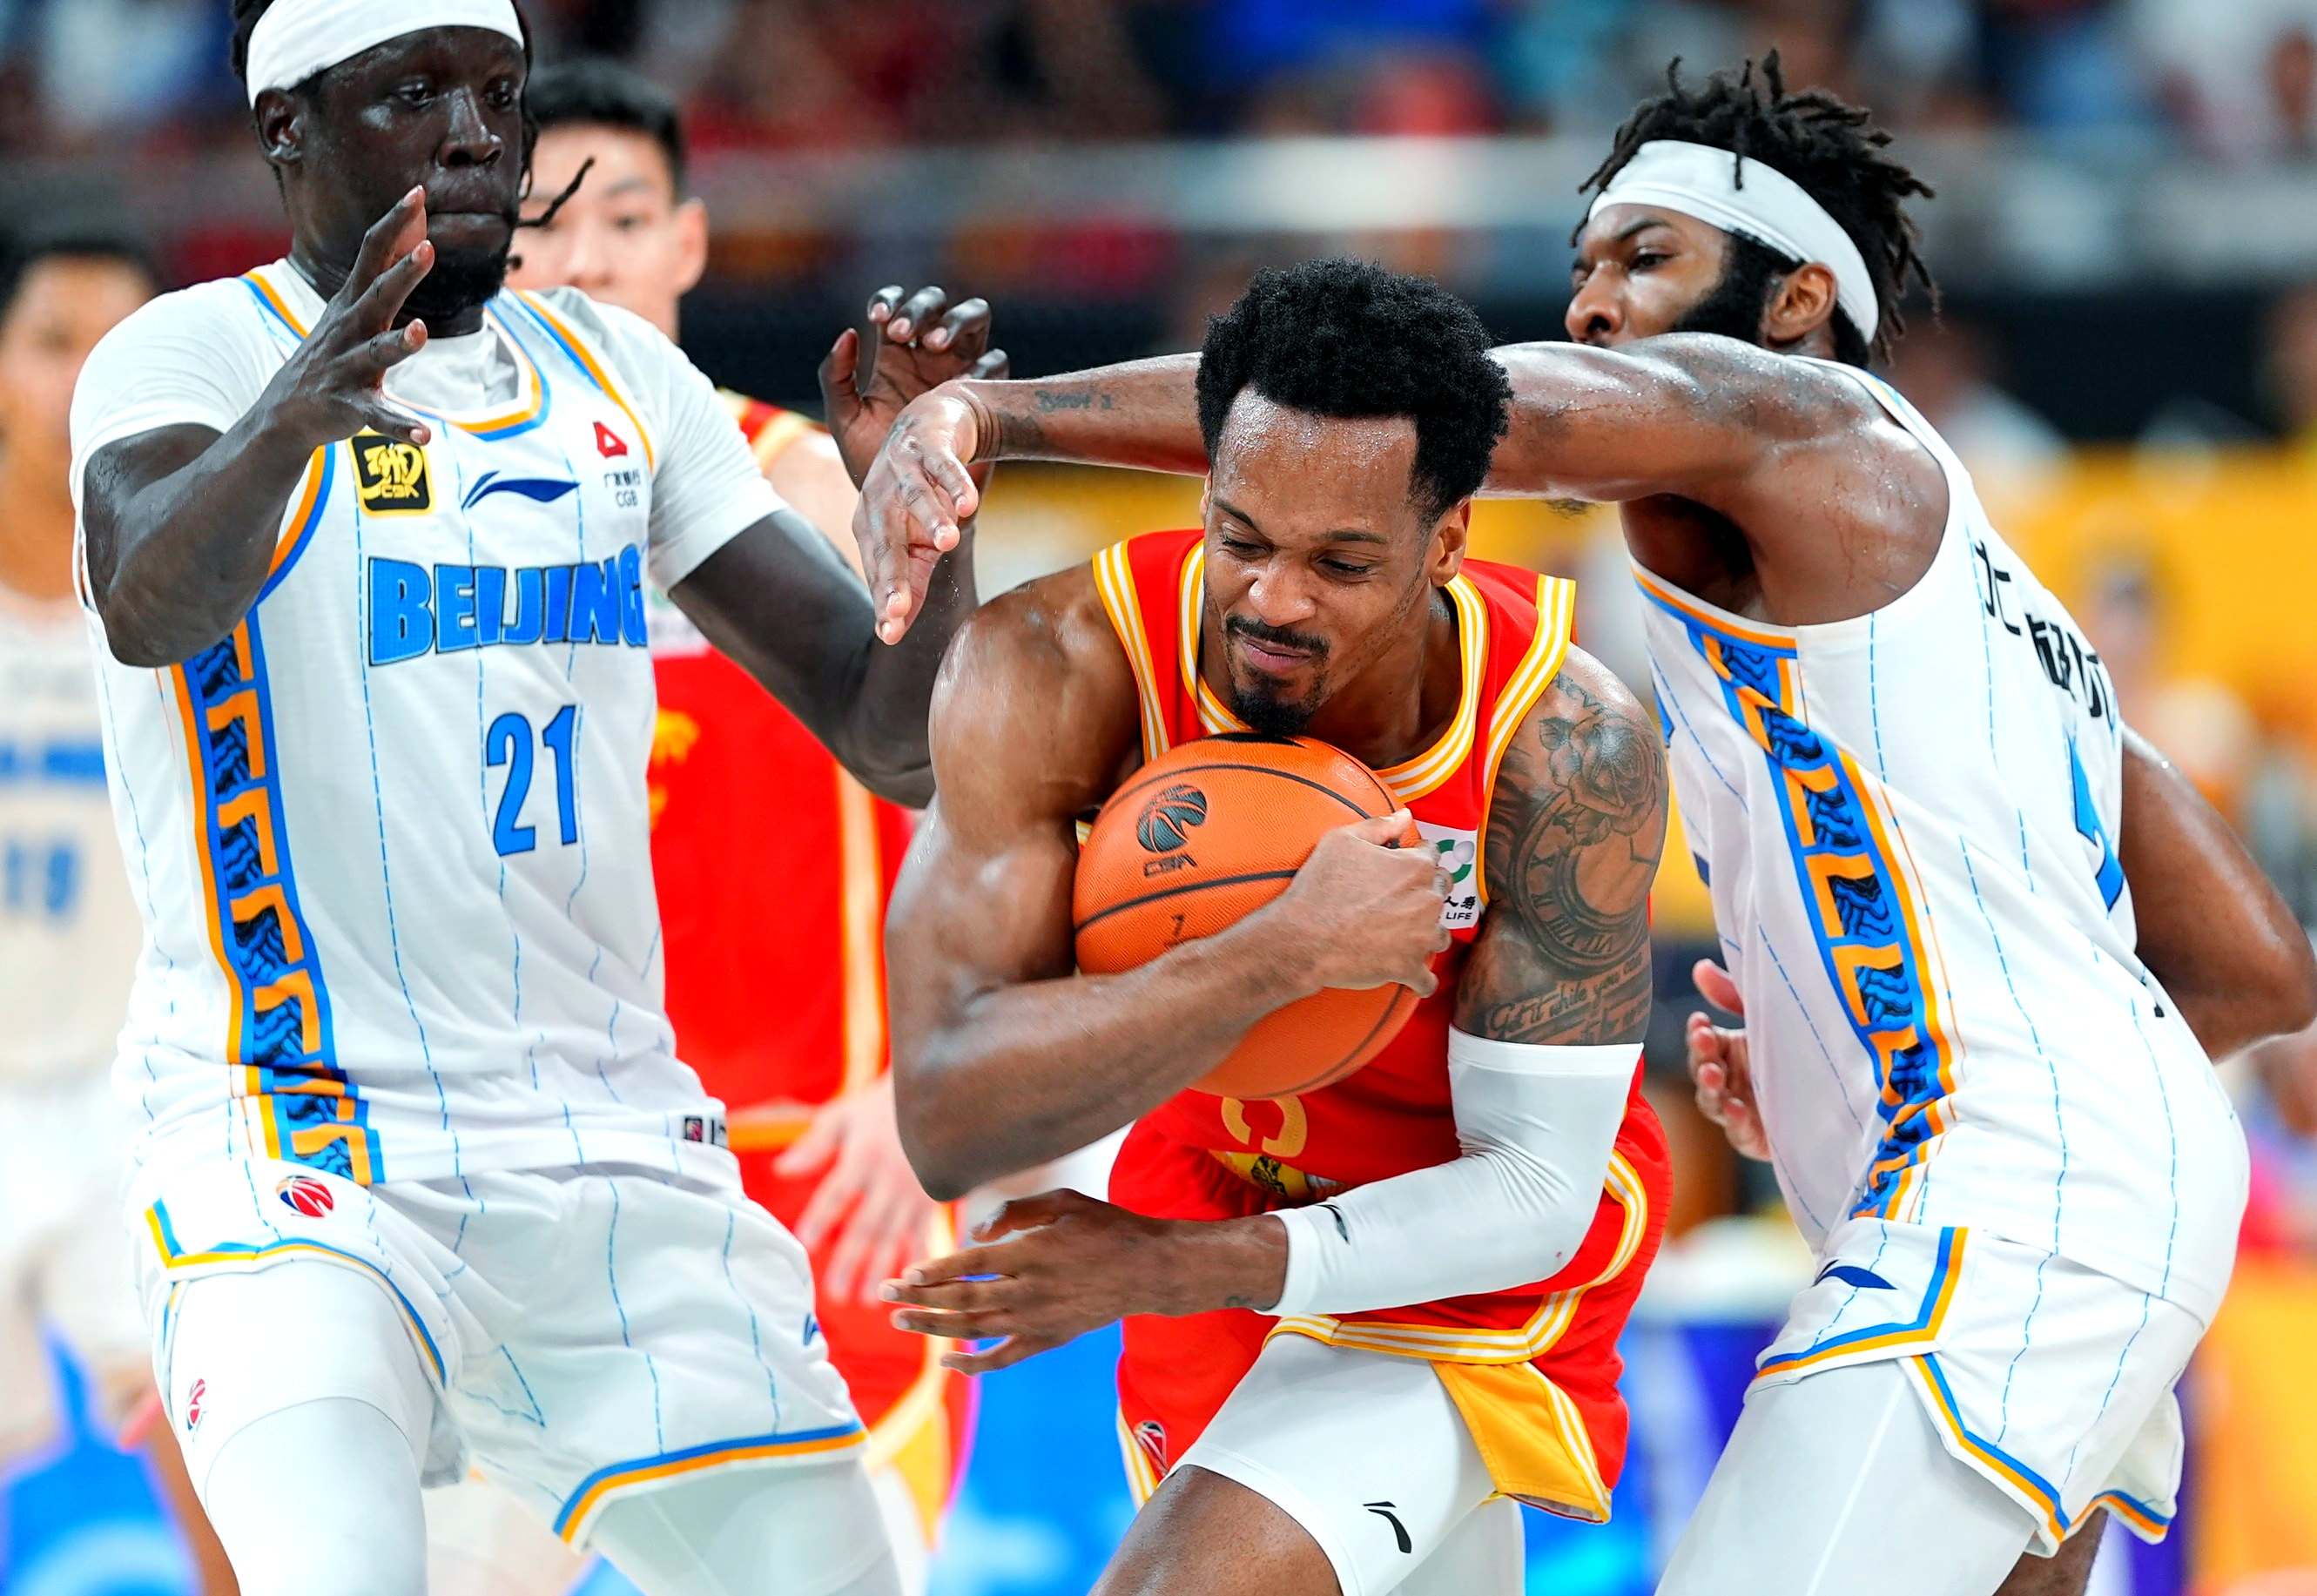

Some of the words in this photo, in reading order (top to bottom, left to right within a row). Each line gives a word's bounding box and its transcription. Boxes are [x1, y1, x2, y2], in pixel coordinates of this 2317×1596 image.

[615, 490, 638, 507] CGB
[368, 543, 648, 666] BEIJING
[487, 704, 578, 857] 21
